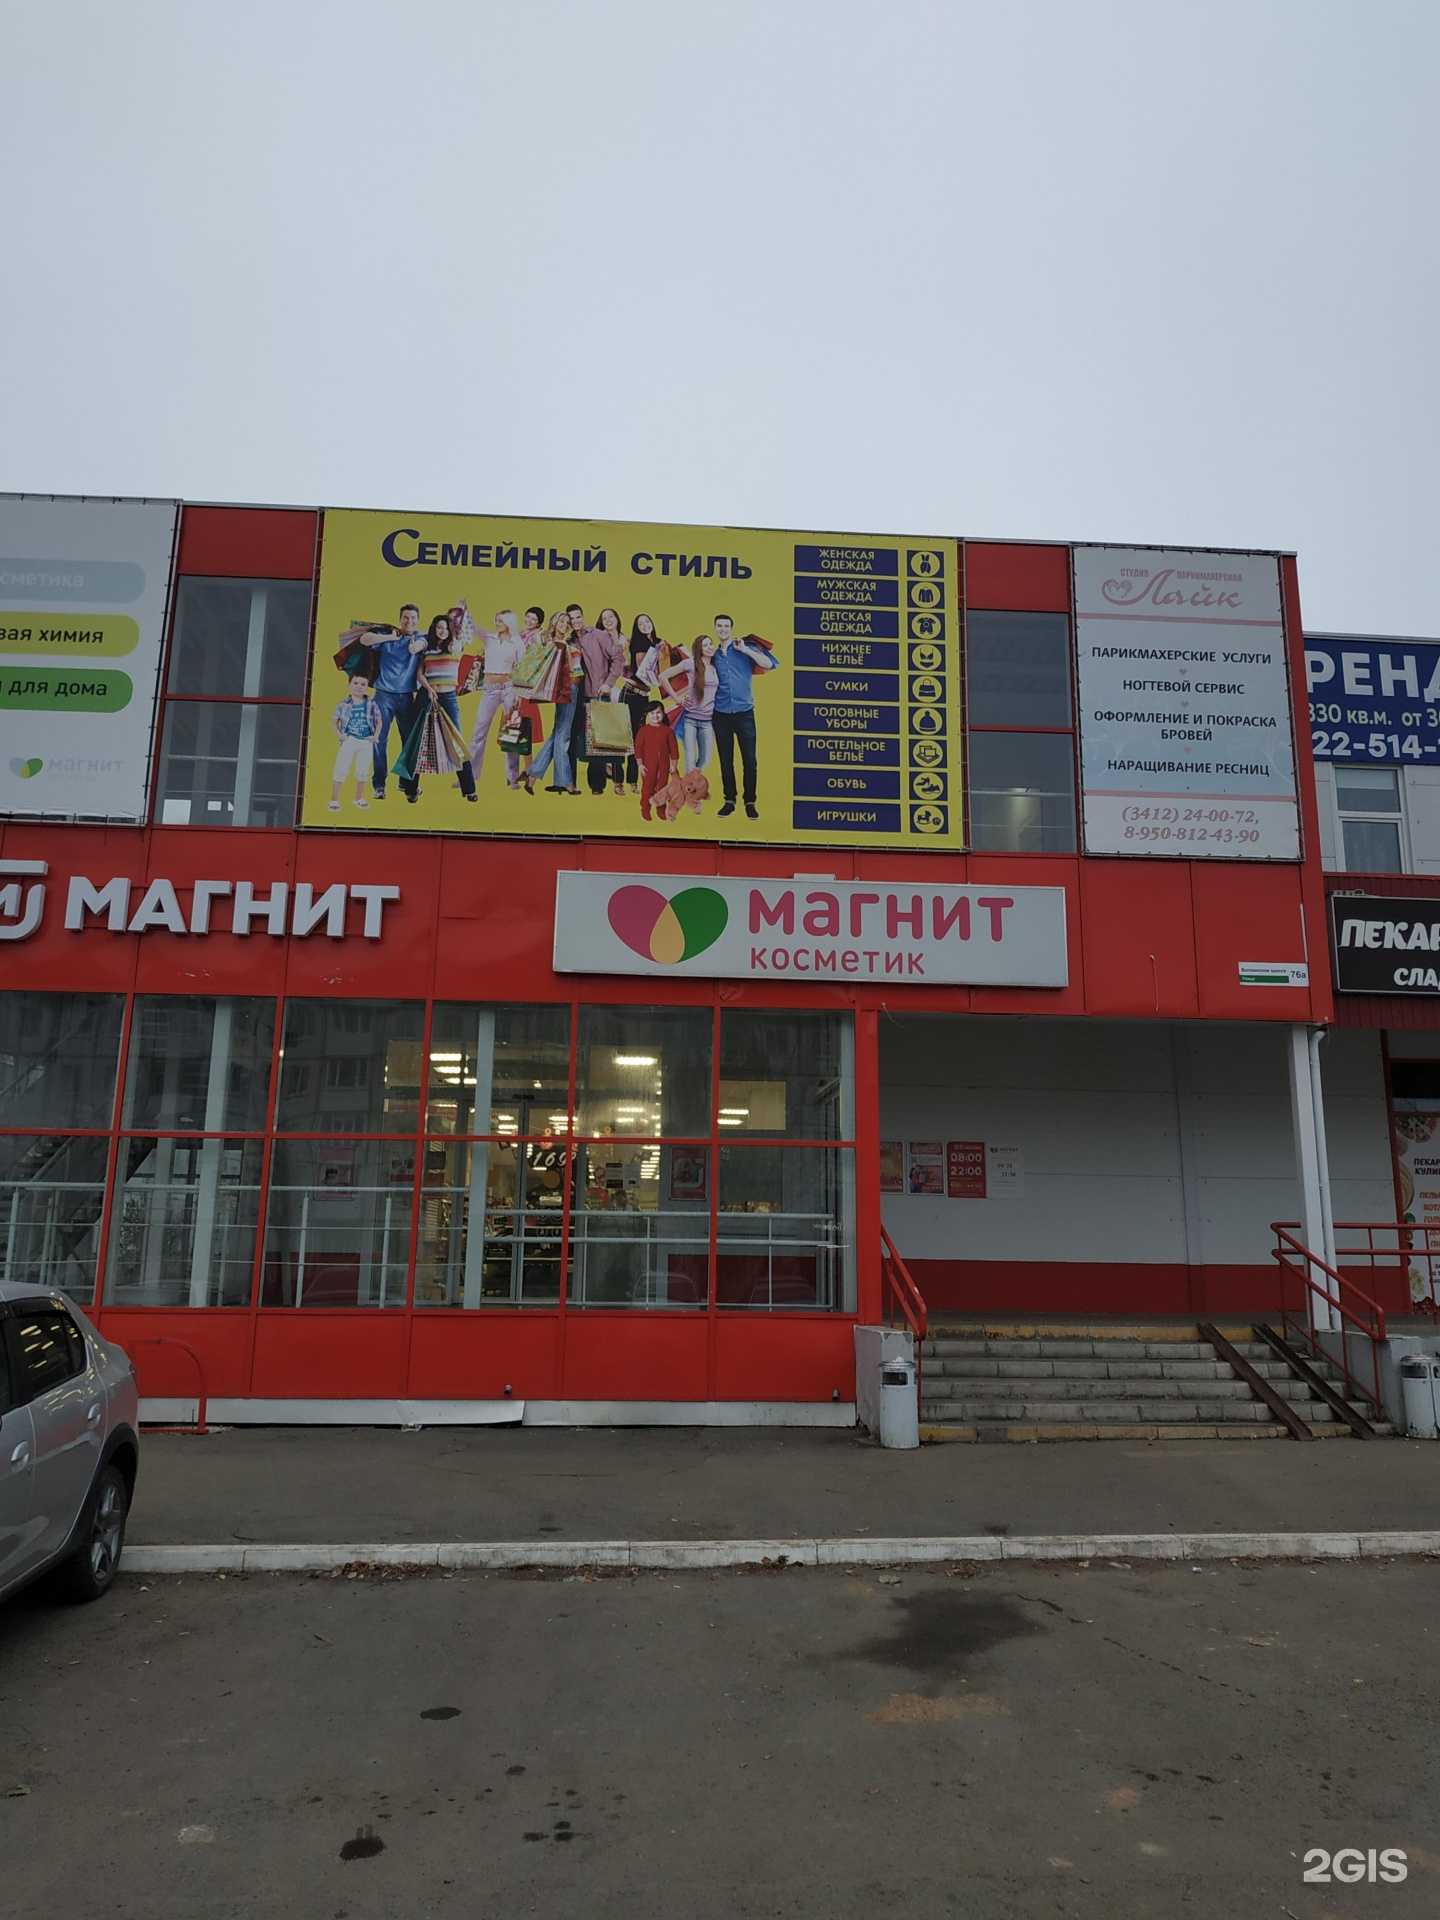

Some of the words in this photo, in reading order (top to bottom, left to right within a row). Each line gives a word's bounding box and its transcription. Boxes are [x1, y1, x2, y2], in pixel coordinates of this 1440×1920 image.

[819, 548, 875, 561] ЖЕНСКАЯ
[821, 559, 873, 572] ОДЕЖДА
[816, 579, 877, 592] МУЖСКАЯ
[821, 589, 873, 602] ОДЕЖДА
[820, 610, 872, 623] ДЕТСКАЯ
[820, 621, 873, 634] ОДЕЖДА
[38, 629, 104, 644] химия
[822, 643, 872, 655] НИЖНЕЕ
[829, 652, 865, 665] БЕЛЬЁ
[1092, 647, 1216, 663] ПАРИКМАХЕРСКИЕ
[1223, 652, 1271, 665] УСЛУГИ
[8, 681, 48, 695] для
[54, 682, 108, 697] дома
[824, 680, 869, 692] СУМКИ
[1123, 679, 1191, 694] НОГТЕВОЙ
[1195, 683, 1245, 696] СЕРВИС
[814, 707, 880, 720] ГОЛОВНЫЕ
[1094, 710, 1189, 725] ОФОРМЛЕНИЕ
[1192, 714, 1203, 725] И
[1207, 715, 1277, 728] ПОКРАСКА
[1426, 708, 1440, 727] 3
[825, 718, 868, 730] УБОРЫ
[1160, 728, 1213, 742] БРОВЕЙ
[807, 739, 887, 752] ПОСТЕЛЬНОЕ
[1312, 730, 1440, 759] 22-514-
[829, 749, 865, 762] БЕЛЬЁ
[1107, 760, 1212, 774] НАРАЩИВАНИЕ
[1215, 764, 1270, 777] РЕСНИЦ
[826, 777, 868, 790] ОБУВЬ
[817, 810, 877, 823] ИГРУШКИ
[1121, 806, 1179, 822] (3412)
[1123, 826, 1260, 843] 8-950-812-43-90
[63, 875, 401, 939] МАГНИТ
[749, 946, 926, 976] косметик
[950, 1153, 983, 1163] 08:00
[950, 1166, 983, 1177] 22:00
